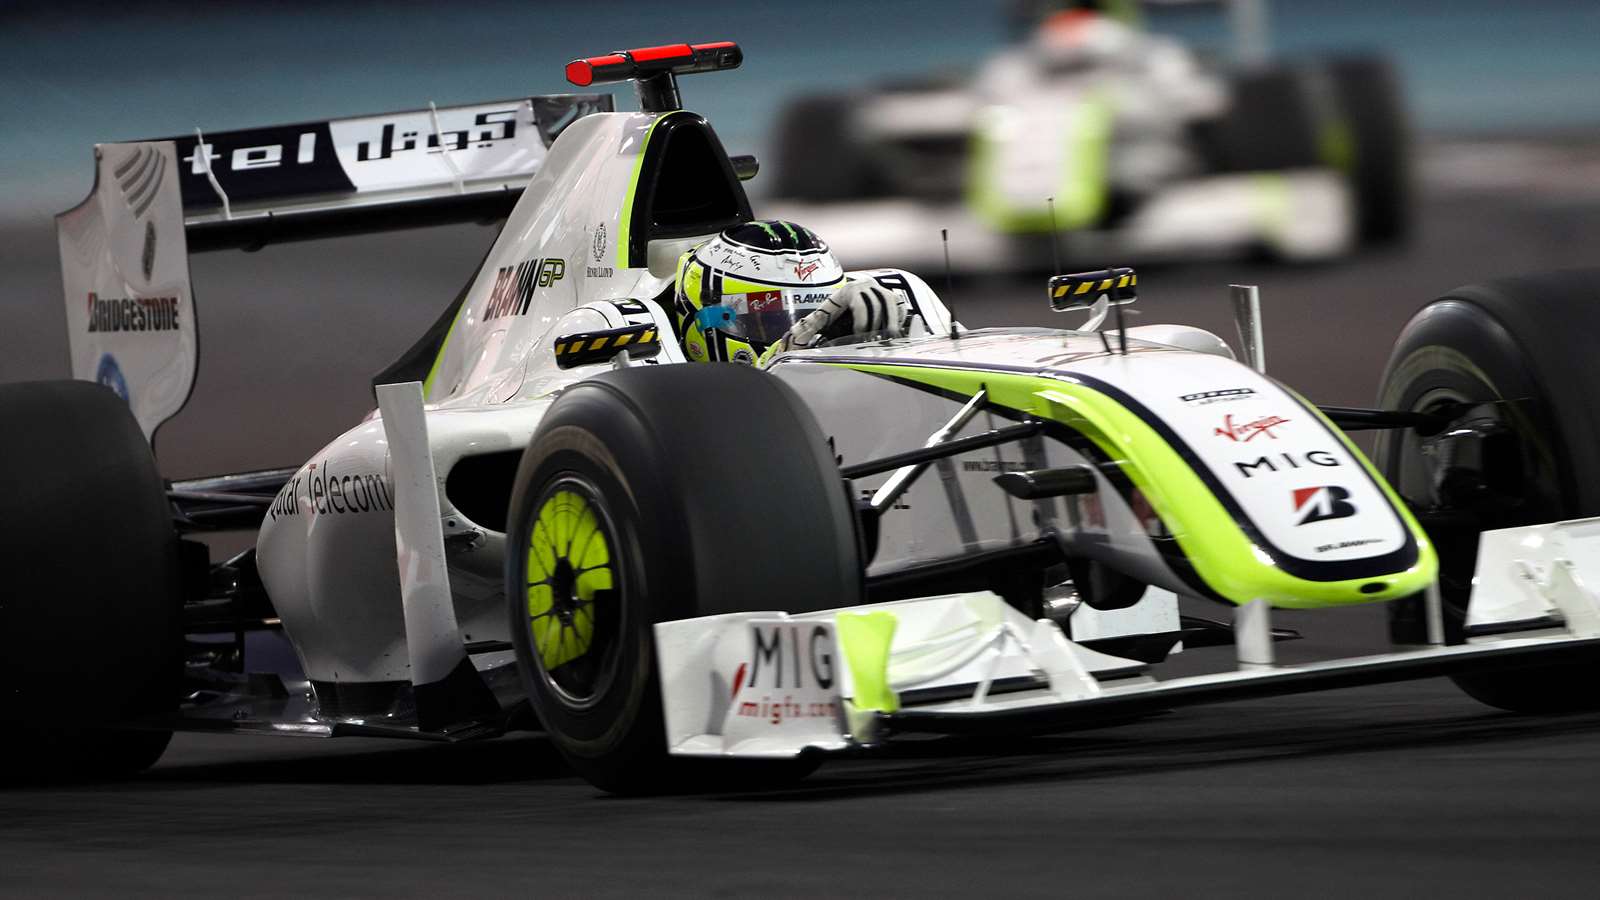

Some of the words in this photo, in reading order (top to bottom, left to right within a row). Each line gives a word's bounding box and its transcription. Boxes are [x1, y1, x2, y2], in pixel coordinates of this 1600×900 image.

[88, 292, 179, 332] BRIDGESTONE
[1214, 414, 1291, 442] Virgin
[1234, 450, 1341, 478] MIG
[308, 459, 393, 515] Telecom
[749, 625, 834, 690] MIG
